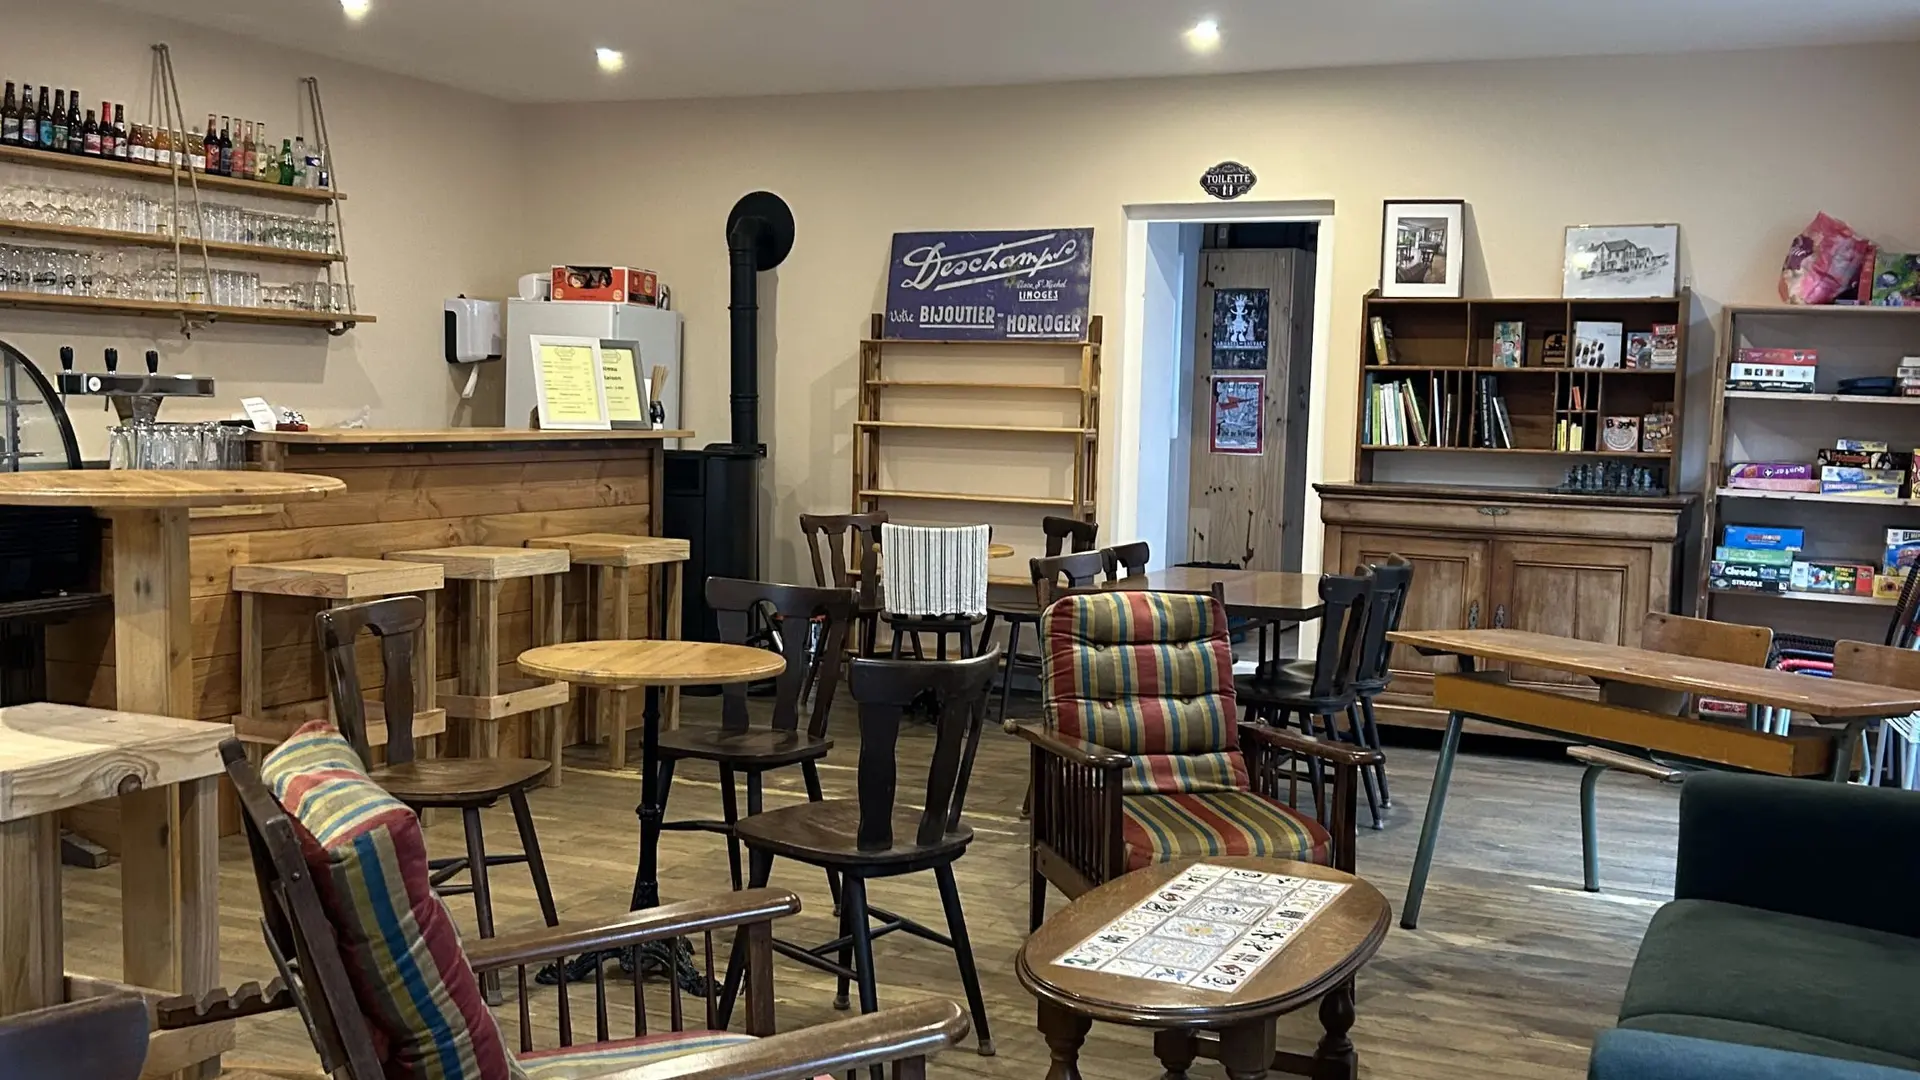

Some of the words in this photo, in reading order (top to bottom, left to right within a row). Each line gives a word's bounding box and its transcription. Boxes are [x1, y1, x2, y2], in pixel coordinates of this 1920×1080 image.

[1206, 174, 1251, 184] TOILETTE
[901, 238, 1077, 291] Deschamps
[1019, 290, 1058, 300] LIMOGES
[920, 305, 995, 323] BIJOUTIER
[1006, 314, 1081, 333] HORLOGER
